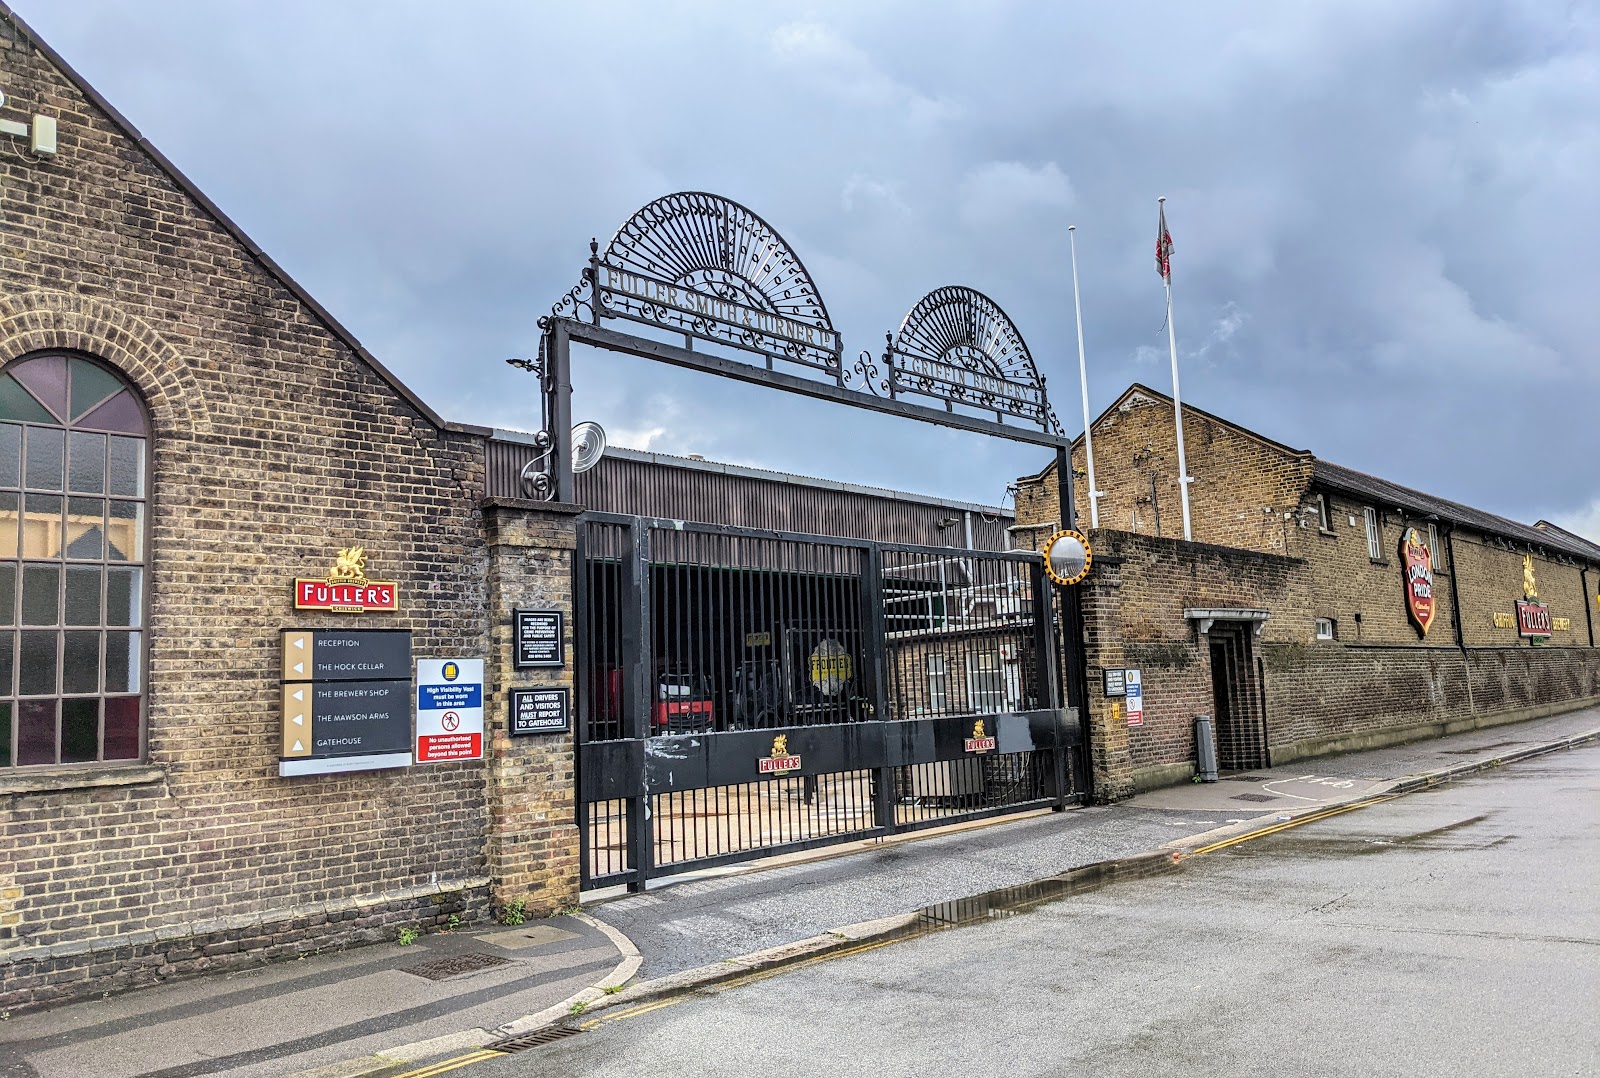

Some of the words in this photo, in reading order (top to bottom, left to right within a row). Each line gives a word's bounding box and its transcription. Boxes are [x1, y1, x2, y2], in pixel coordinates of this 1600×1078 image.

[685, 292, 738, 324] SMITH
[742, 309, 753, 327] &
[755, 312, 814, 343] TURNER
[912, 358, 965, 385] GRIFFIN
[974, 375, 1029, 400] BREWERY
[1408, 564, 1433, 585] LONDON
[304, 585, 390, 604] FULLER'S
[1414, 583, 1431, 597] PRIDE
[1521, 607, 1549, 631] FULLER'S
[318, 639, 360, 647] RECEPTION
[318, 663, 332, 671] THE
[334, 663, 356, 671] HOCK
[318, 690, 332, 698] THE
[334, 690, 368, 698] BREWERY
[369, 689, 389, 697] SHOP
[522, 694, 533, 702] ALL
[317, 714, 332, 722] THE
[334, 713, 368, 722] MAWSON
[369, 712, 389, 720] ARMS
[520, 711, 536, 719] MUST
[538, 710, 560, 718] REPORT
[529, 718, 563, 726] GATEHOUSE
[317, 737, 361, 746] GATEHOUSE
[762, 758, 799, 771] FULLER'S
